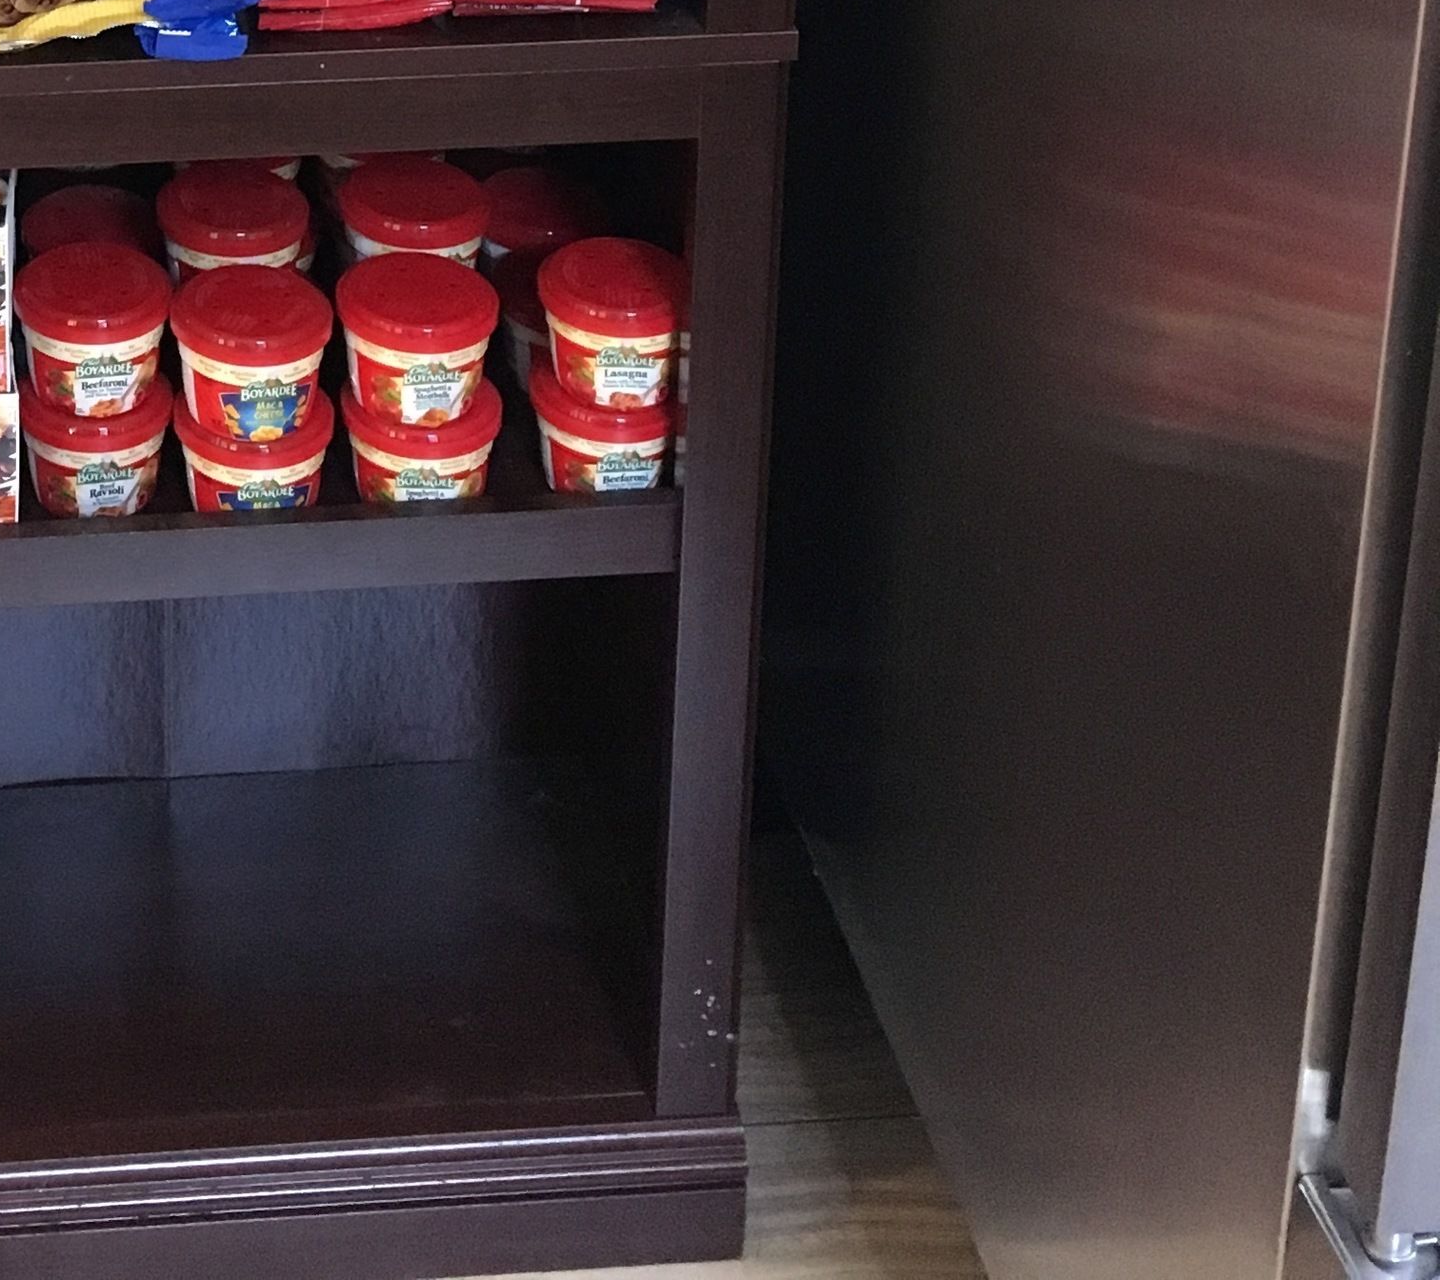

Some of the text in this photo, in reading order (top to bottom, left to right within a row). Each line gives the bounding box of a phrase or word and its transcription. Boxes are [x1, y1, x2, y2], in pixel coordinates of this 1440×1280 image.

[596, 353, 656, 368] BOYARDEE
[75, 361, 134, 378] BOYARDEE
[403, 369, 461, 384] BOYARDEE
[604, 368, 648, 380] Lasagna
[81, 378, 129, 390] Beefaroni
[240, 384, 298, 402] BOYARDEE
[597, 455, 655, 471] BOYARDEE
[76, 467, 135, 485] BOYARDEE
[395, 474, 455, 489] BOYARDEE
[603, 473, 649, 485] Beefaroni
[90, 486, 125, 500] Ravioli
[237, 485, 296, 502] BOYARDEE
